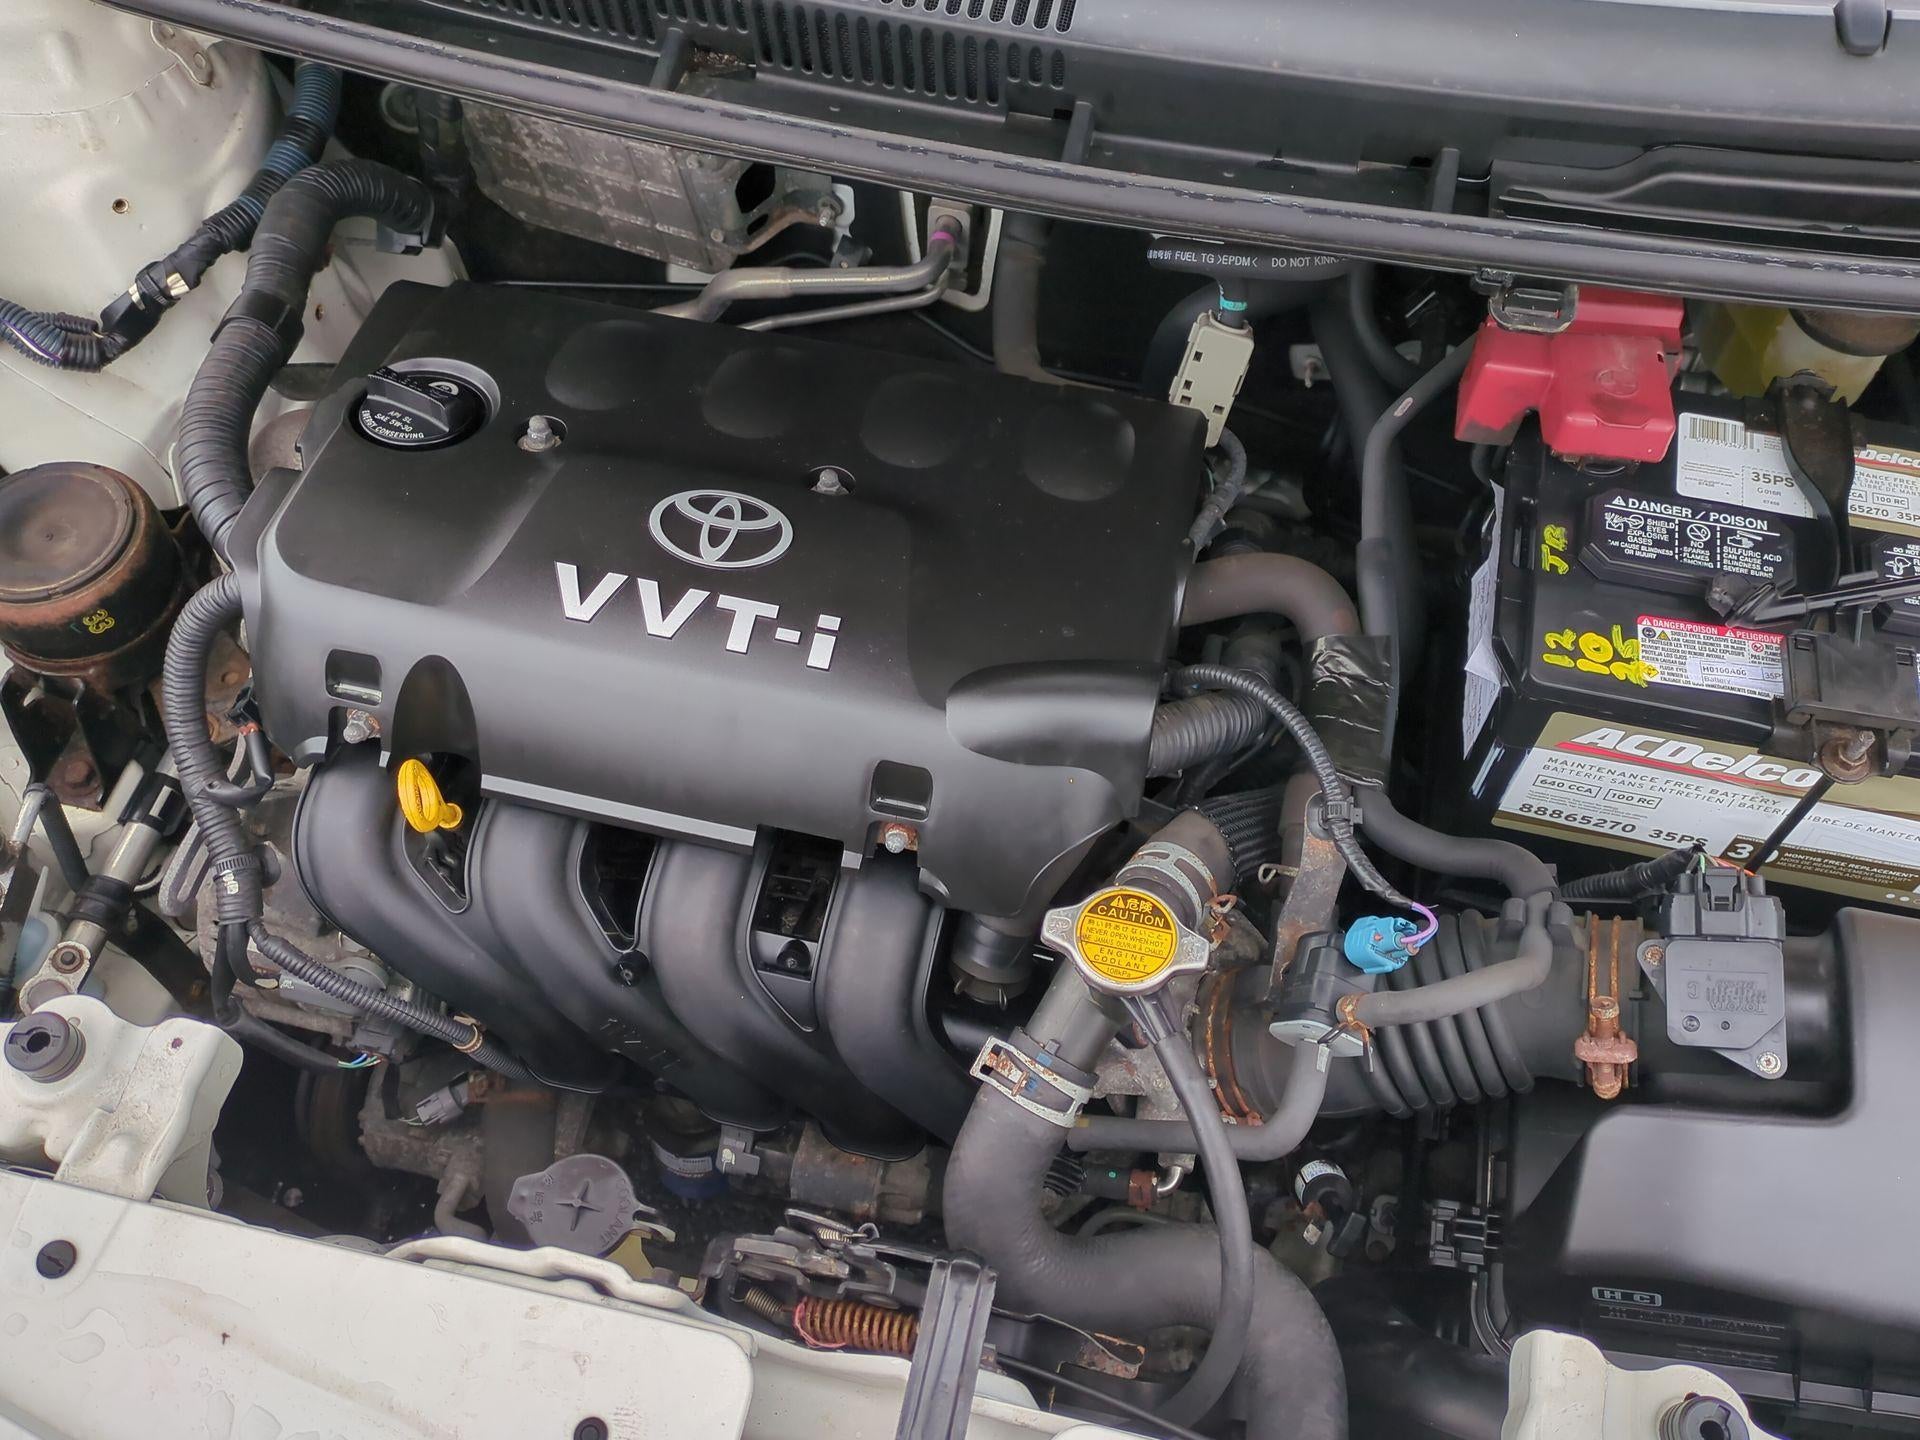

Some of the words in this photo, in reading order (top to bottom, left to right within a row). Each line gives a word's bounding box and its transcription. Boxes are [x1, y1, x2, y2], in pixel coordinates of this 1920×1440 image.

[1175, 251, 1197, 262] FUEL
[1201, 253, 1214, 264] TG
[1272, 257, 1287, 268] DO
[1290, 257, 1311, 267] NOT
[374, 413, 388, 423] SAE
[389, 419, 413, 432] 5W-30
[376, 426, 425, 440] CONSERVING
[1751, 471, 1795, 489] 35PS
[1628, 498, 1692, 518] DANGER
[1710, 512, 1767, 530] POISON
[1897, 511, 1920, 522] 35P
[1647, 519, 1675, 529] SHIELD
[1647, 526, 1667, 534] EYES
[1627, 529, 1669, 542] EXPLOSIVE
[1627, 536, 1652, 545] GASES
[1723, 546, 1761, 558] SULFURIC
[1763, 553, 1782, 562] ACID
[1739, 556, 1762, 565] CAUSE
[1723, 560, 1761, 570] BLINDNESS
[1723, 565, 1749, 575] SEVERE
[554, 560, 841, 670] VVT-i
[1653, 619, 1718, 634] DANGER/POISON
[1571, 727, 1824, 788] ACDelco
[1539, 779, 1564, 788] 640
[1568, 784, 1594, 795] CCA
[1548, 757, 1660, 784] MAINTENANCE
[1664, 778, 1704, 792] FREE
[1709, 788, 1782, 806] BATTERY
[1542, 765, 1606, 783] BATTERIE
[1610, 777, 1644, 789] SANS
[1649, 785, 1724, 805] ENTRETIEN
[1803, 814, 1841, 826] IBRE
[1843, 821, 1863, 831] DE
[1611, 792, 1634, 802] 100
[1636, 797, 1656, 806] RC
[1519, 803, 1637, 833] 88865270
[1648, 829, 1709, 848] 35PS
[1784, 852, 1823, 863] MONTHS
[1823, 858, 1848, 867] FREE
[1097, 905, 1165, 928] CAUTION
[1087, 928, 1108, 936] NEVER
[1110, 931, 1128, 940] OPEN
[1130, 936, 1148, 944] WHEN
[1100, 947, 1145, 962] ENGINE
[1094, 955, 1148, 971] COOLANT
[1106, 967, 1131, 978] 108kPa
